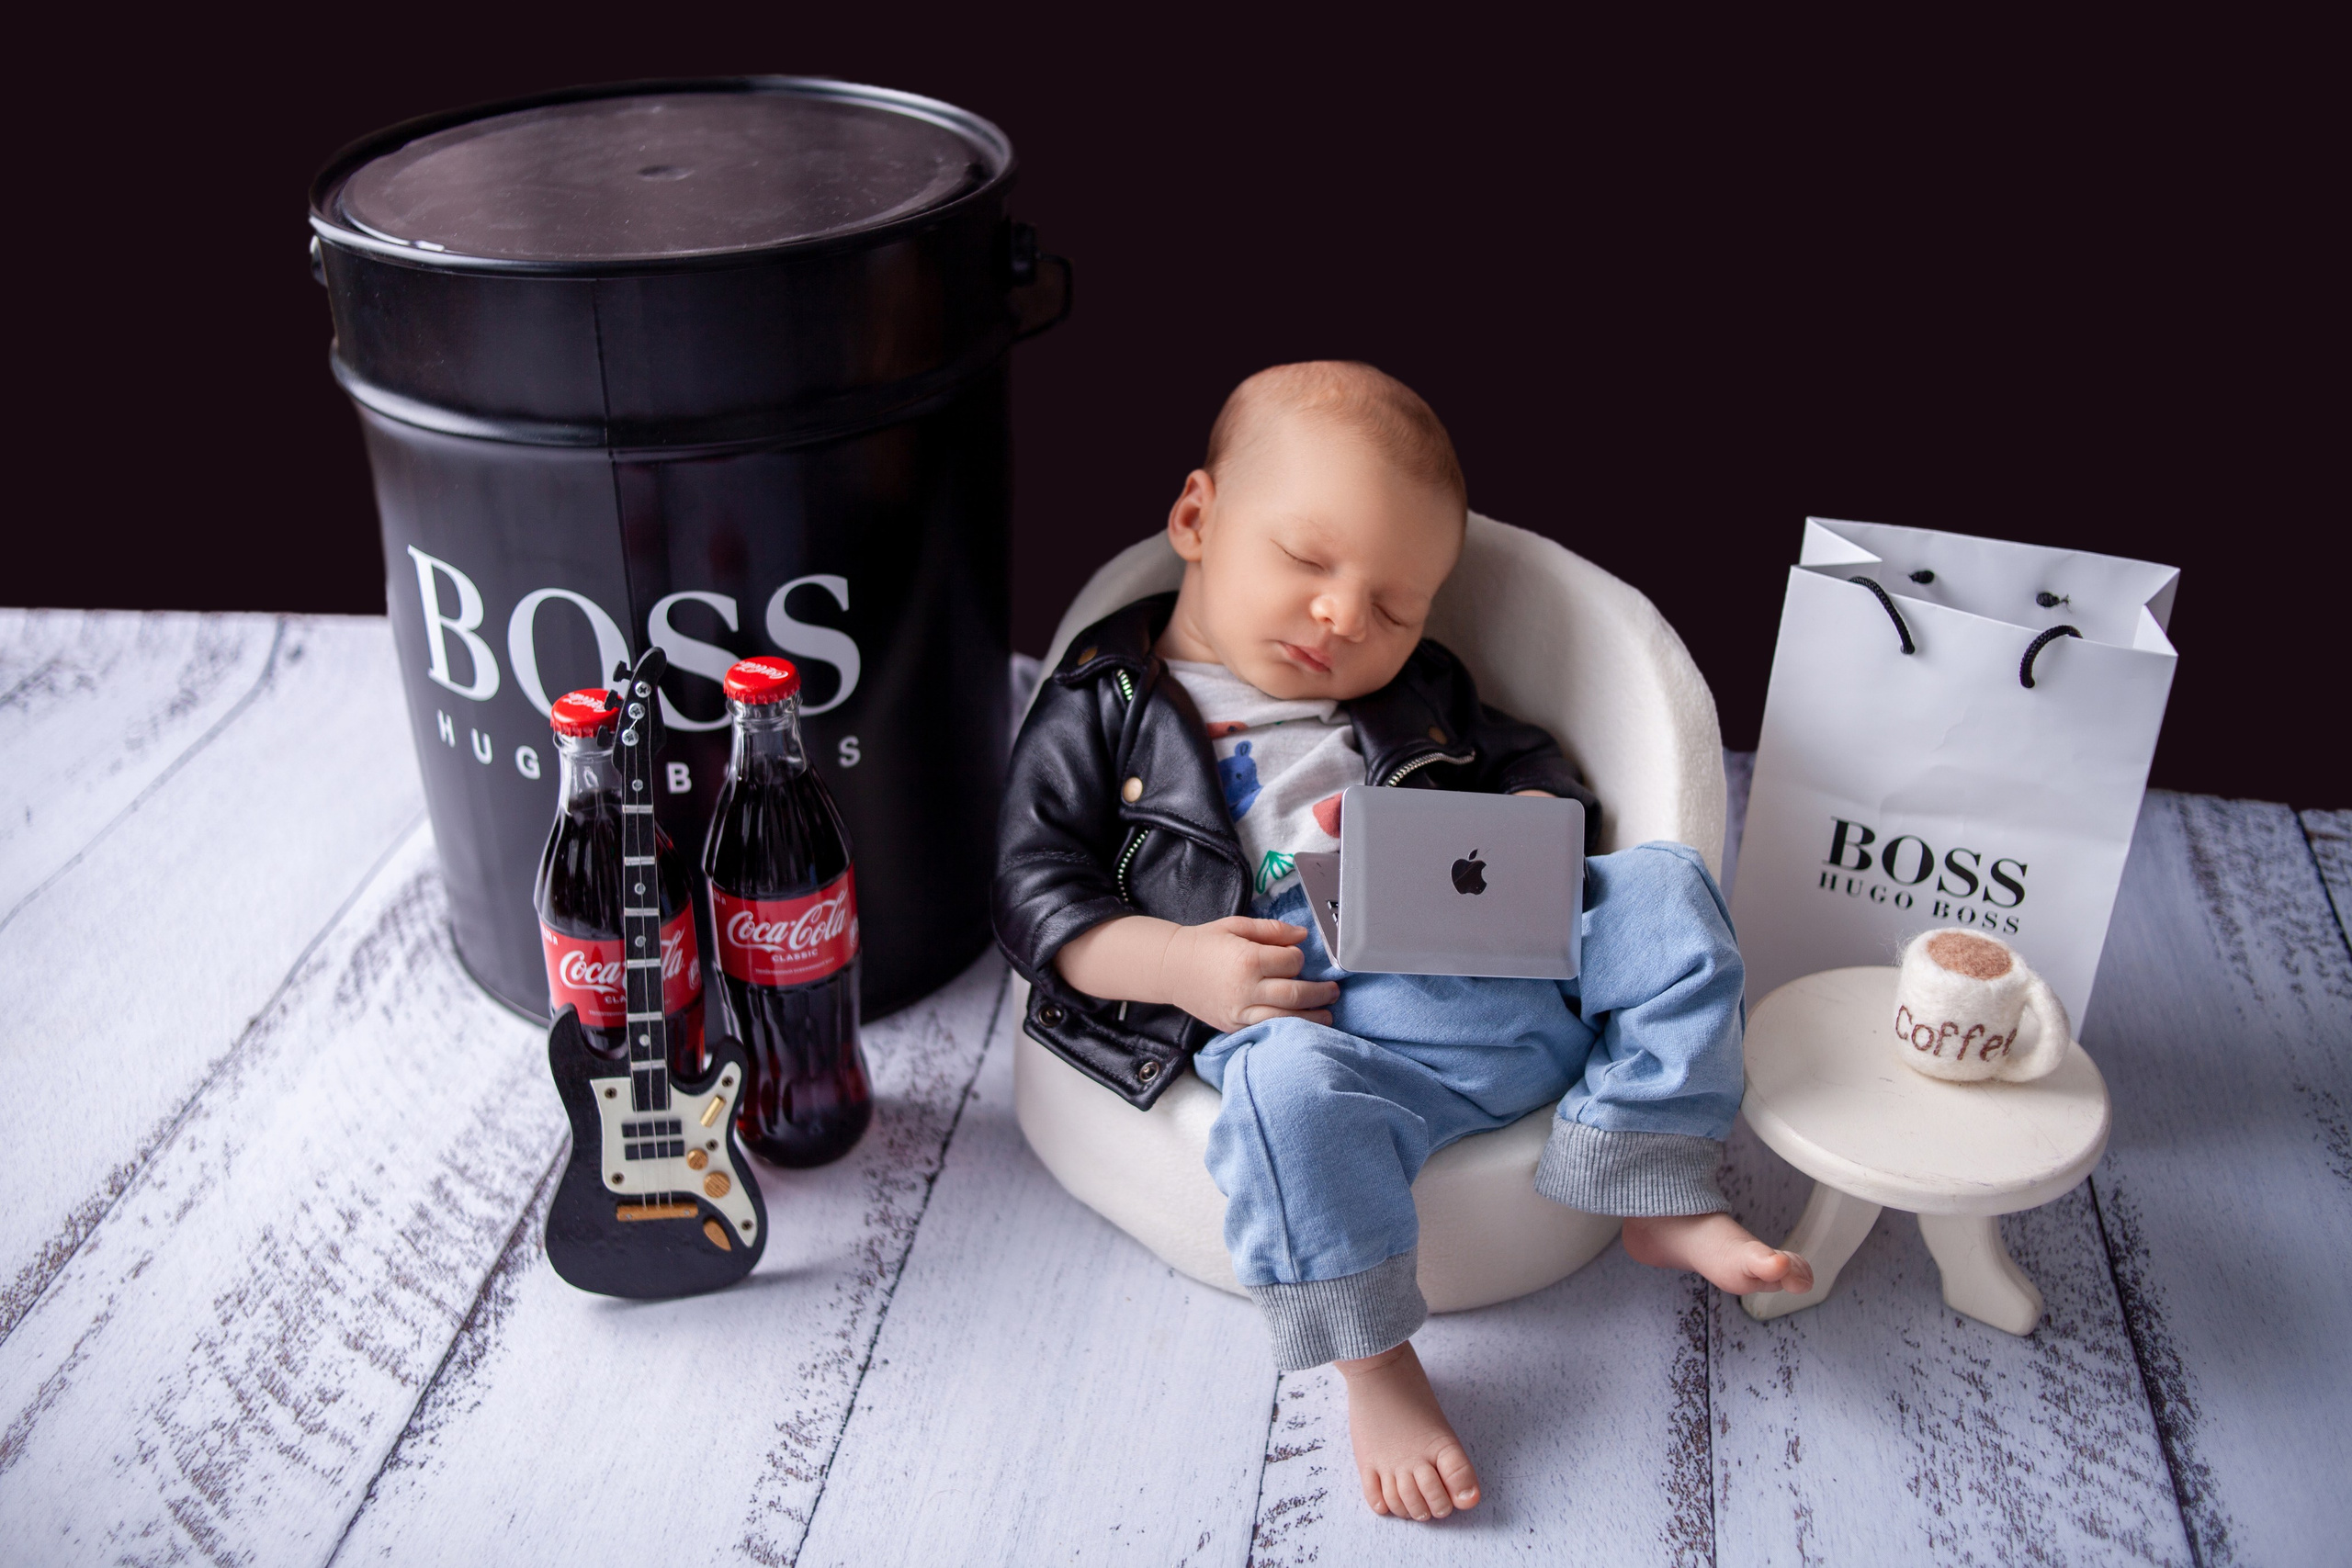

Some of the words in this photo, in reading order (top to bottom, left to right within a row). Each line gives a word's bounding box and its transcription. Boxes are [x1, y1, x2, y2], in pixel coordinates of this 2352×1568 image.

[407, 544, 861, 731] BOSS
[435, 708, 542, 780] HUG
[665, 734, 862, 795] BS
[1822, 815, 2029, 909] BOSS
[727, 888, 849, 953] Coca-Cola
[1817, 871, 1914, 911] HUGO
[1931, 897, 2020, 936] BOSS
[559, 924, 686, 995] Coca-la
[770, 948, 820, 964] CLASSIC
